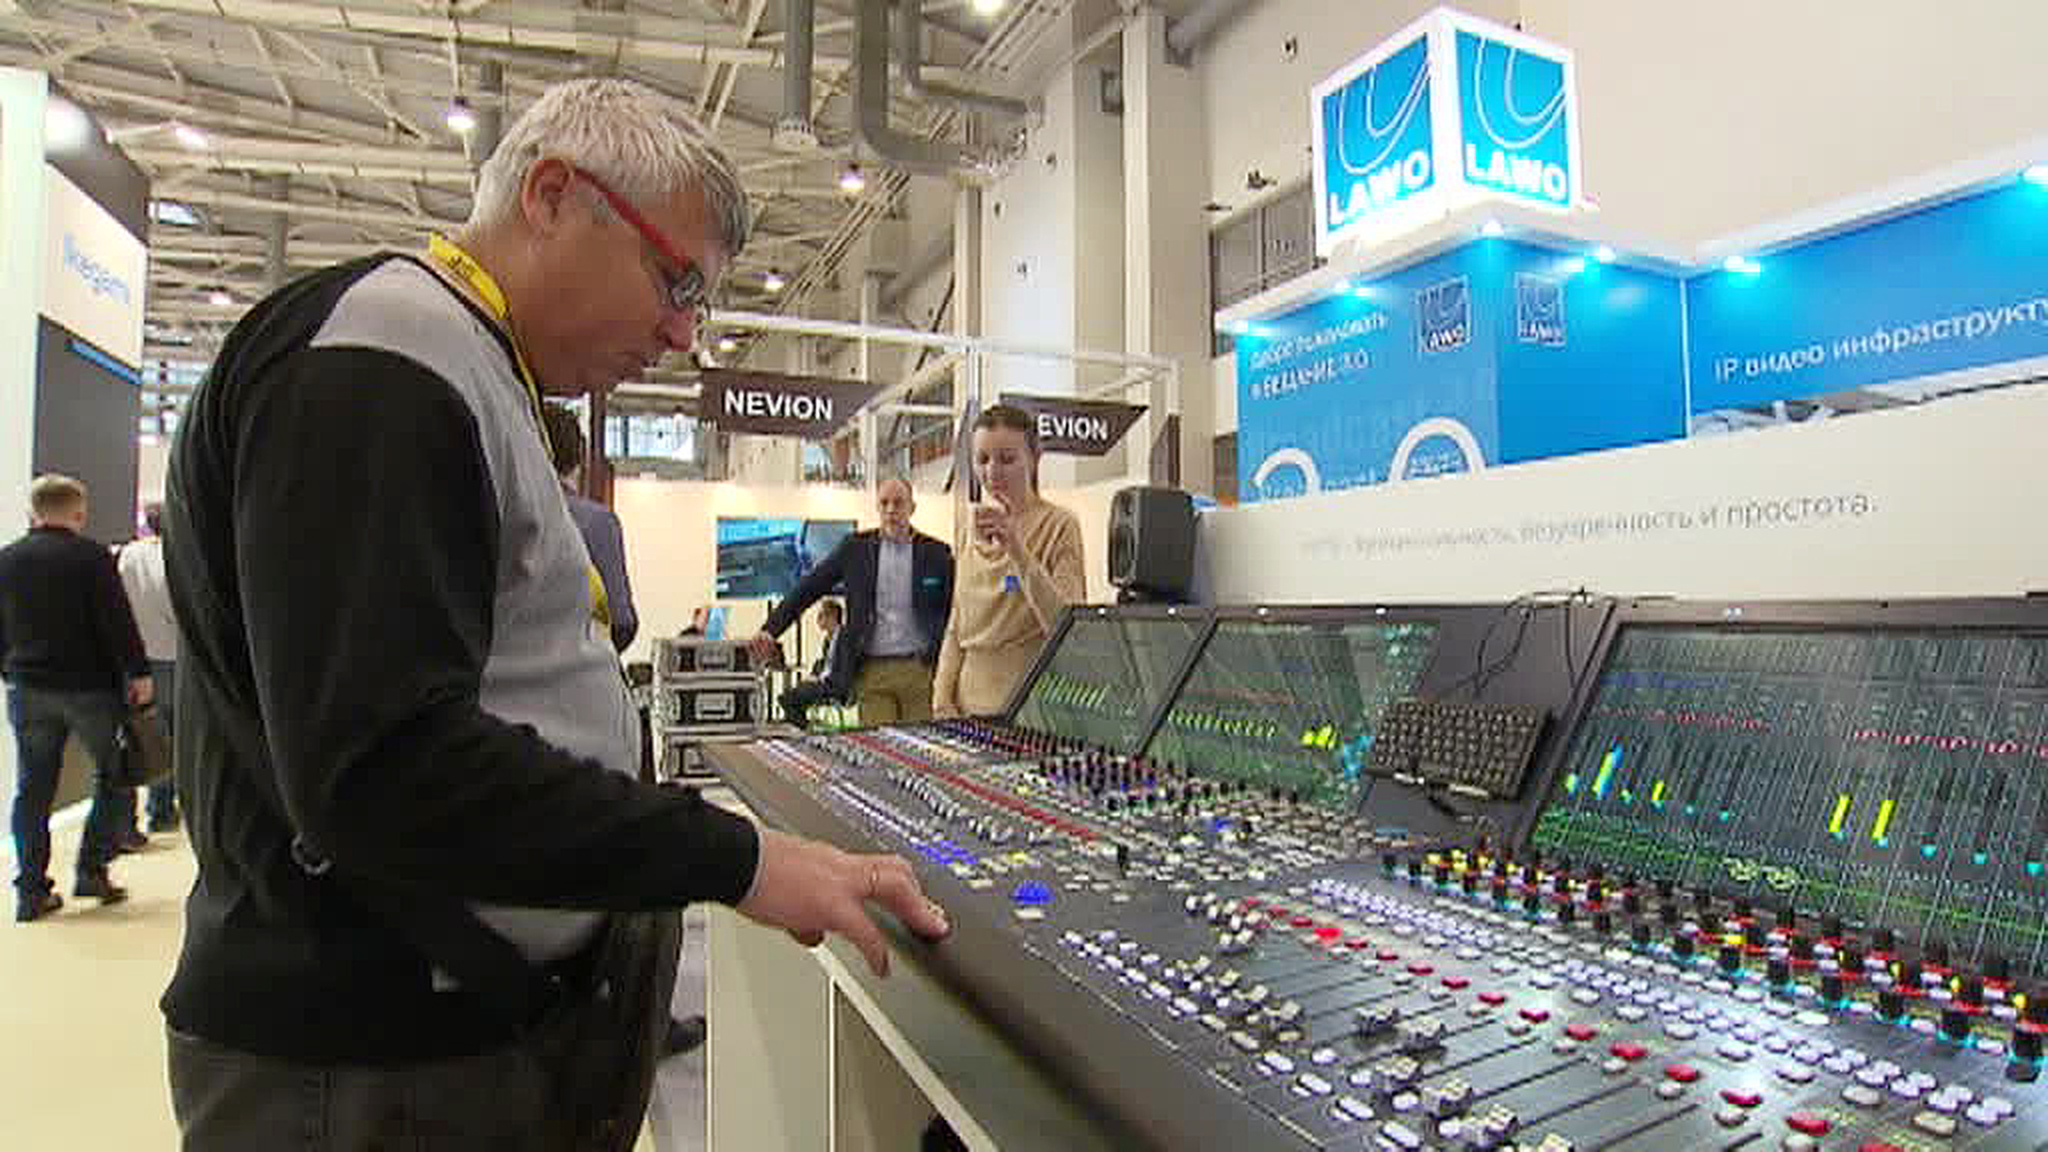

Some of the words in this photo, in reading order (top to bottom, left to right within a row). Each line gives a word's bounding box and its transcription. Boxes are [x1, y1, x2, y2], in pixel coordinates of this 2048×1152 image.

[1330, 149, 1430, 225] LAWO
[1466, 143, 1567, 201] LAWO
[1714, 357, 1738, 384] IP
[1745, 343, 1824, 377] видео
[1832, 298, 2048, 361] инфраструкт
[724, 389, 833, 421] NEVION
[1036, 412, 1109, 441] EVION
